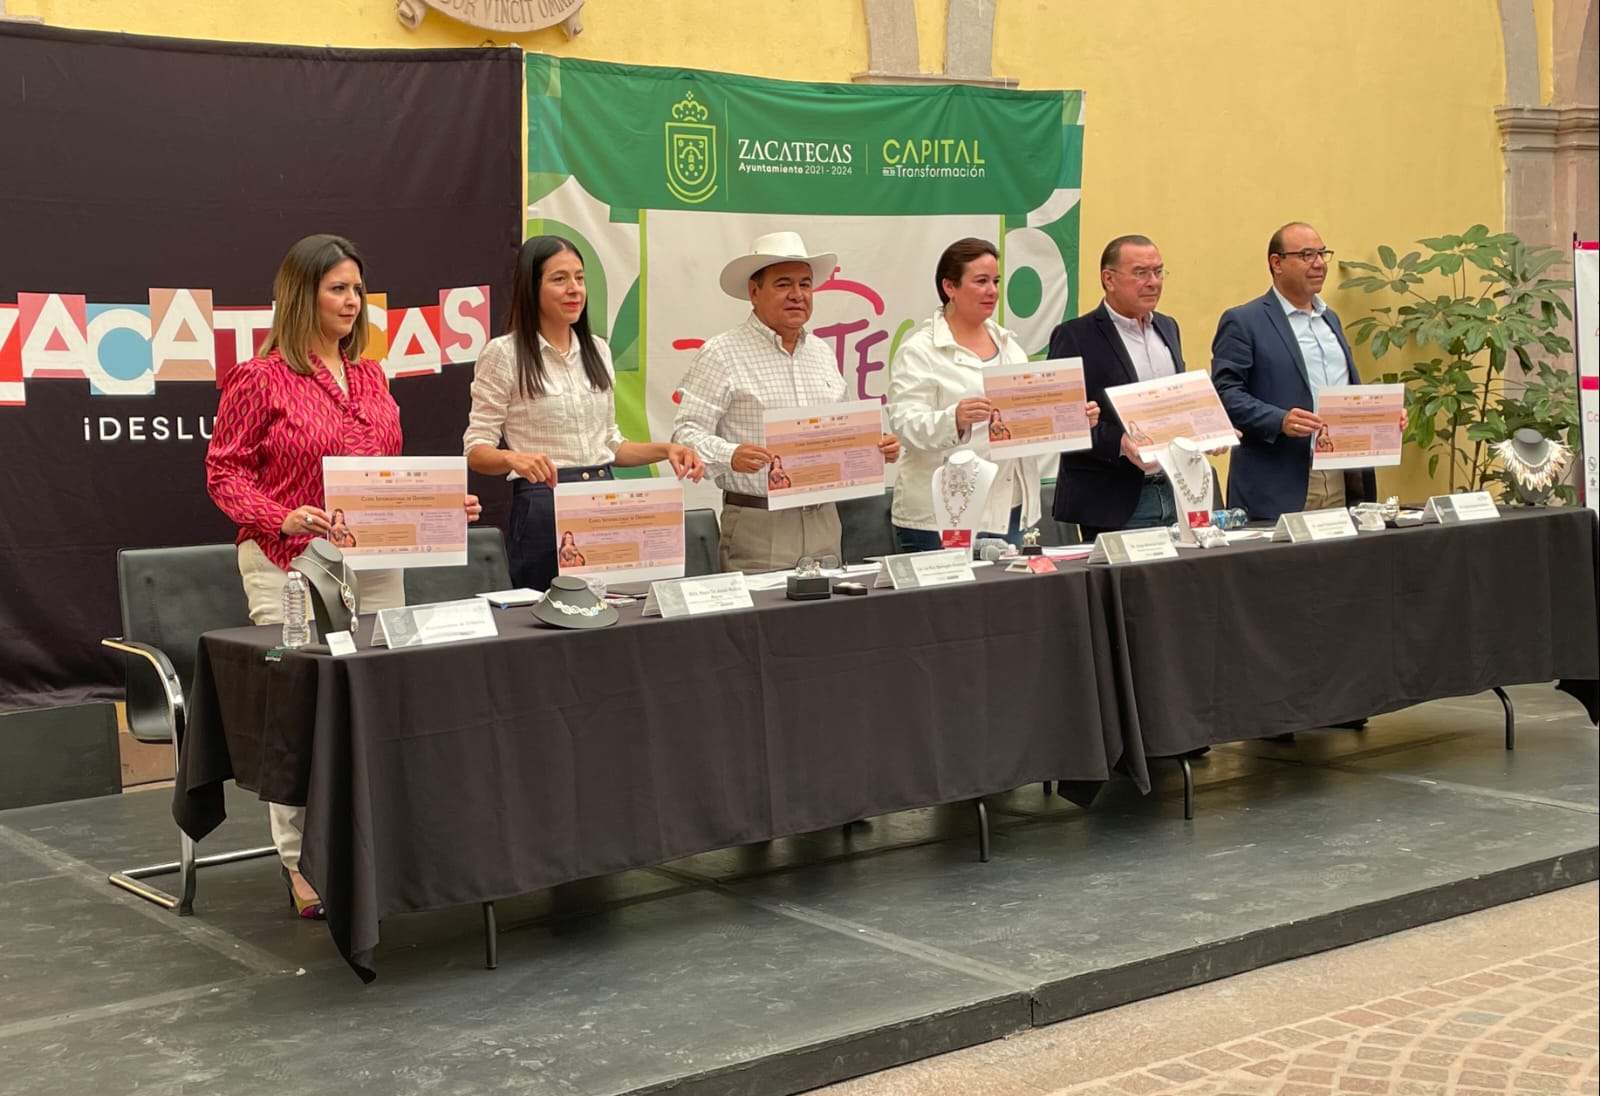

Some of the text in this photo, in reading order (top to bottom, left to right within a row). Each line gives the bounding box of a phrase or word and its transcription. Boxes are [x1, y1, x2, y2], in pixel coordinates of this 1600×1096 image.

[738, 138, 852, 164] ZACATECAS
[882, 139, 985, 164] CAPITAL
[738, 162, 804, 174] Ayuntamiento
[805, 165, 825, 175] 2021
[831, 166, 853, 176] 2024
[895, 164, 985, 178] Transformación
[0, 285, 487, 402] ACATAS
